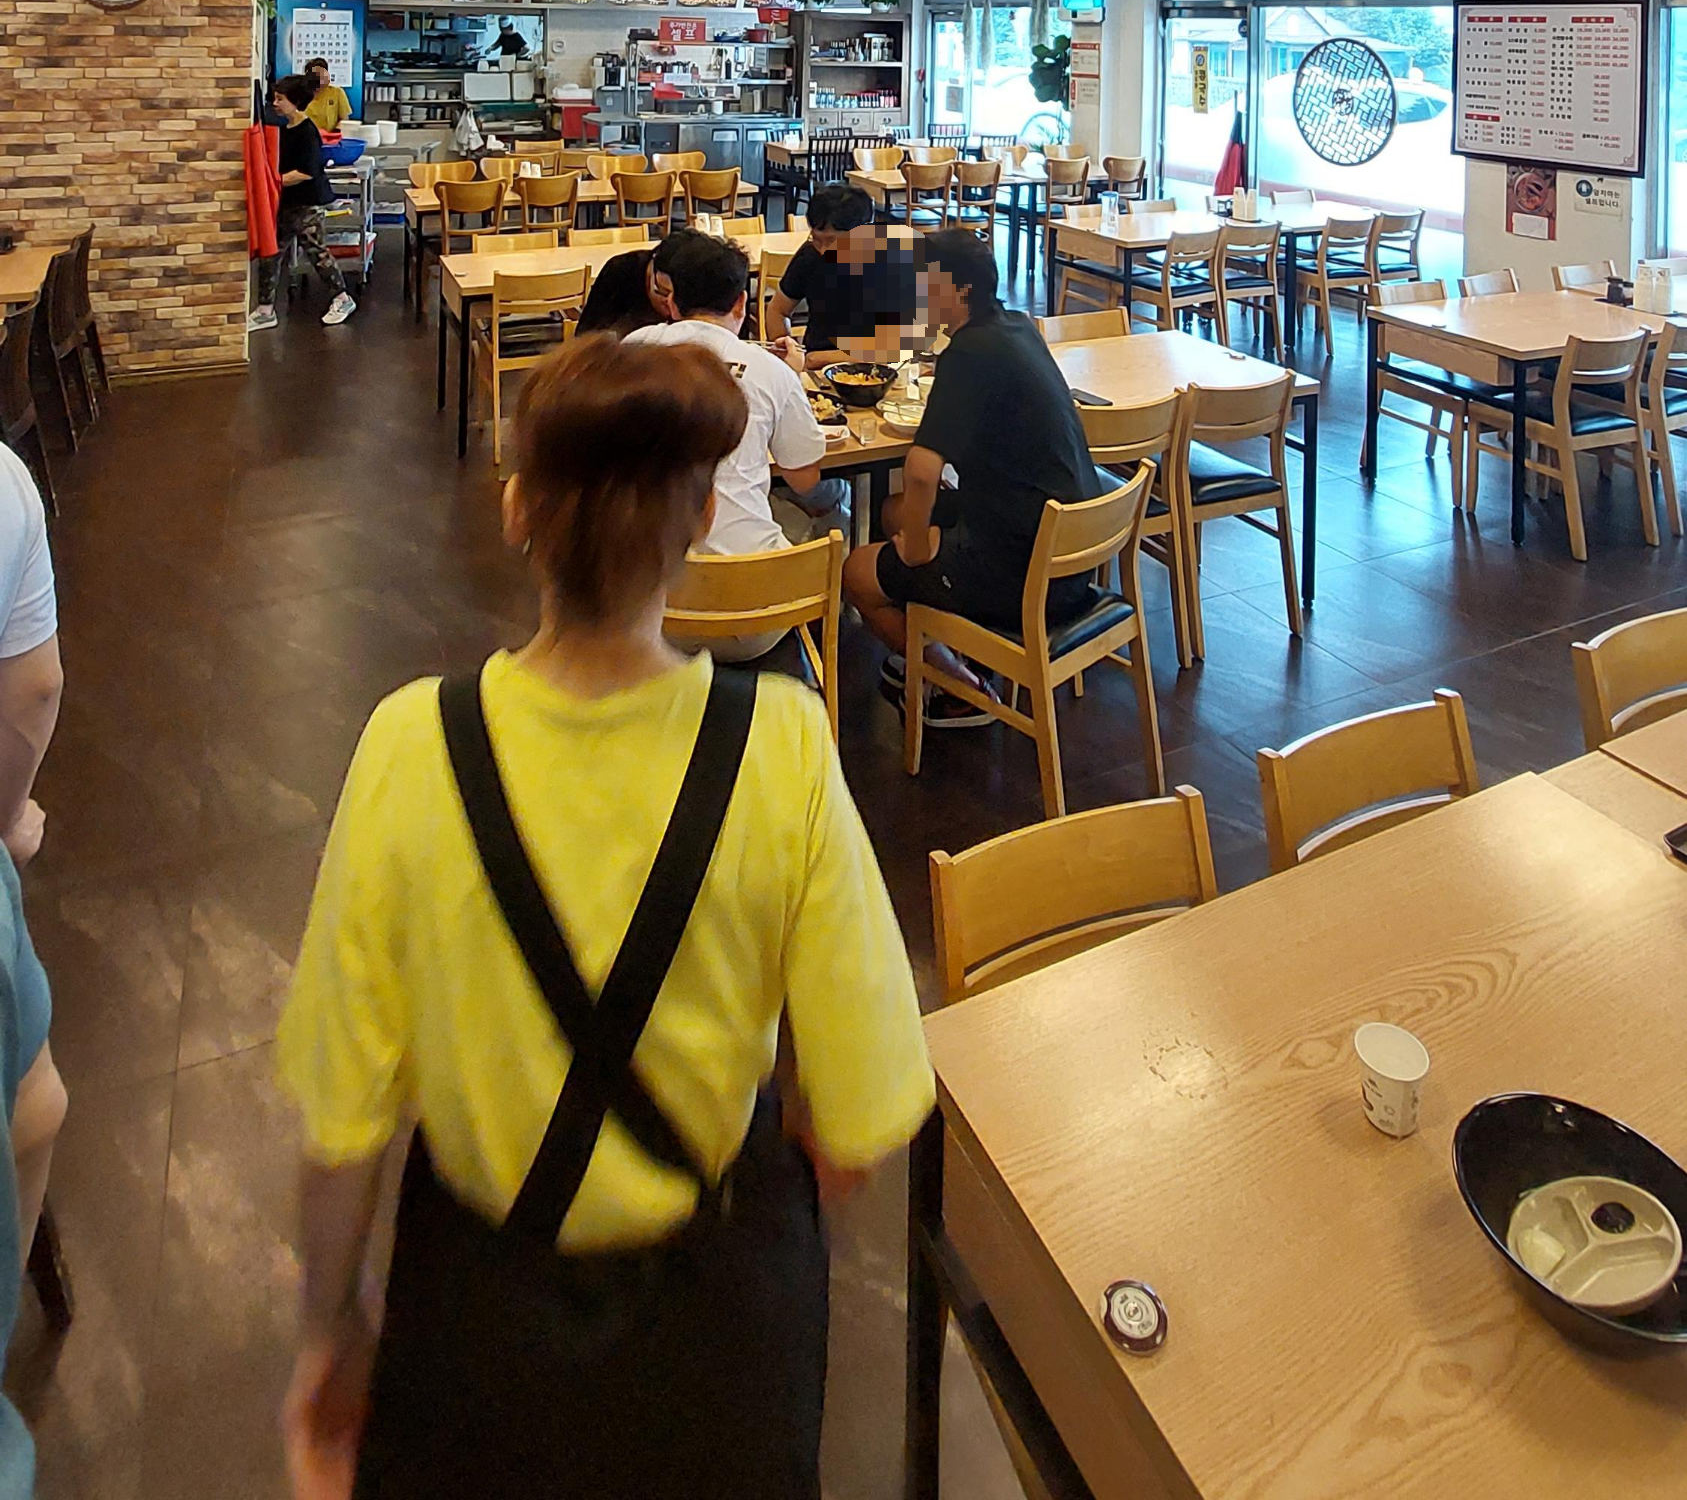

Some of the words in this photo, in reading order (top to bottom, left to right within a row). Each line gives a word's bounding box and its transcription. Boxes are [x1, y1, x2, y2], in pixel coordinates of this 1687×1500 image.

[319, 13, 326, 21] 9
[670, 29, 696, 41] 셀프
[1198, 69, 1206, 107] 콩국수
